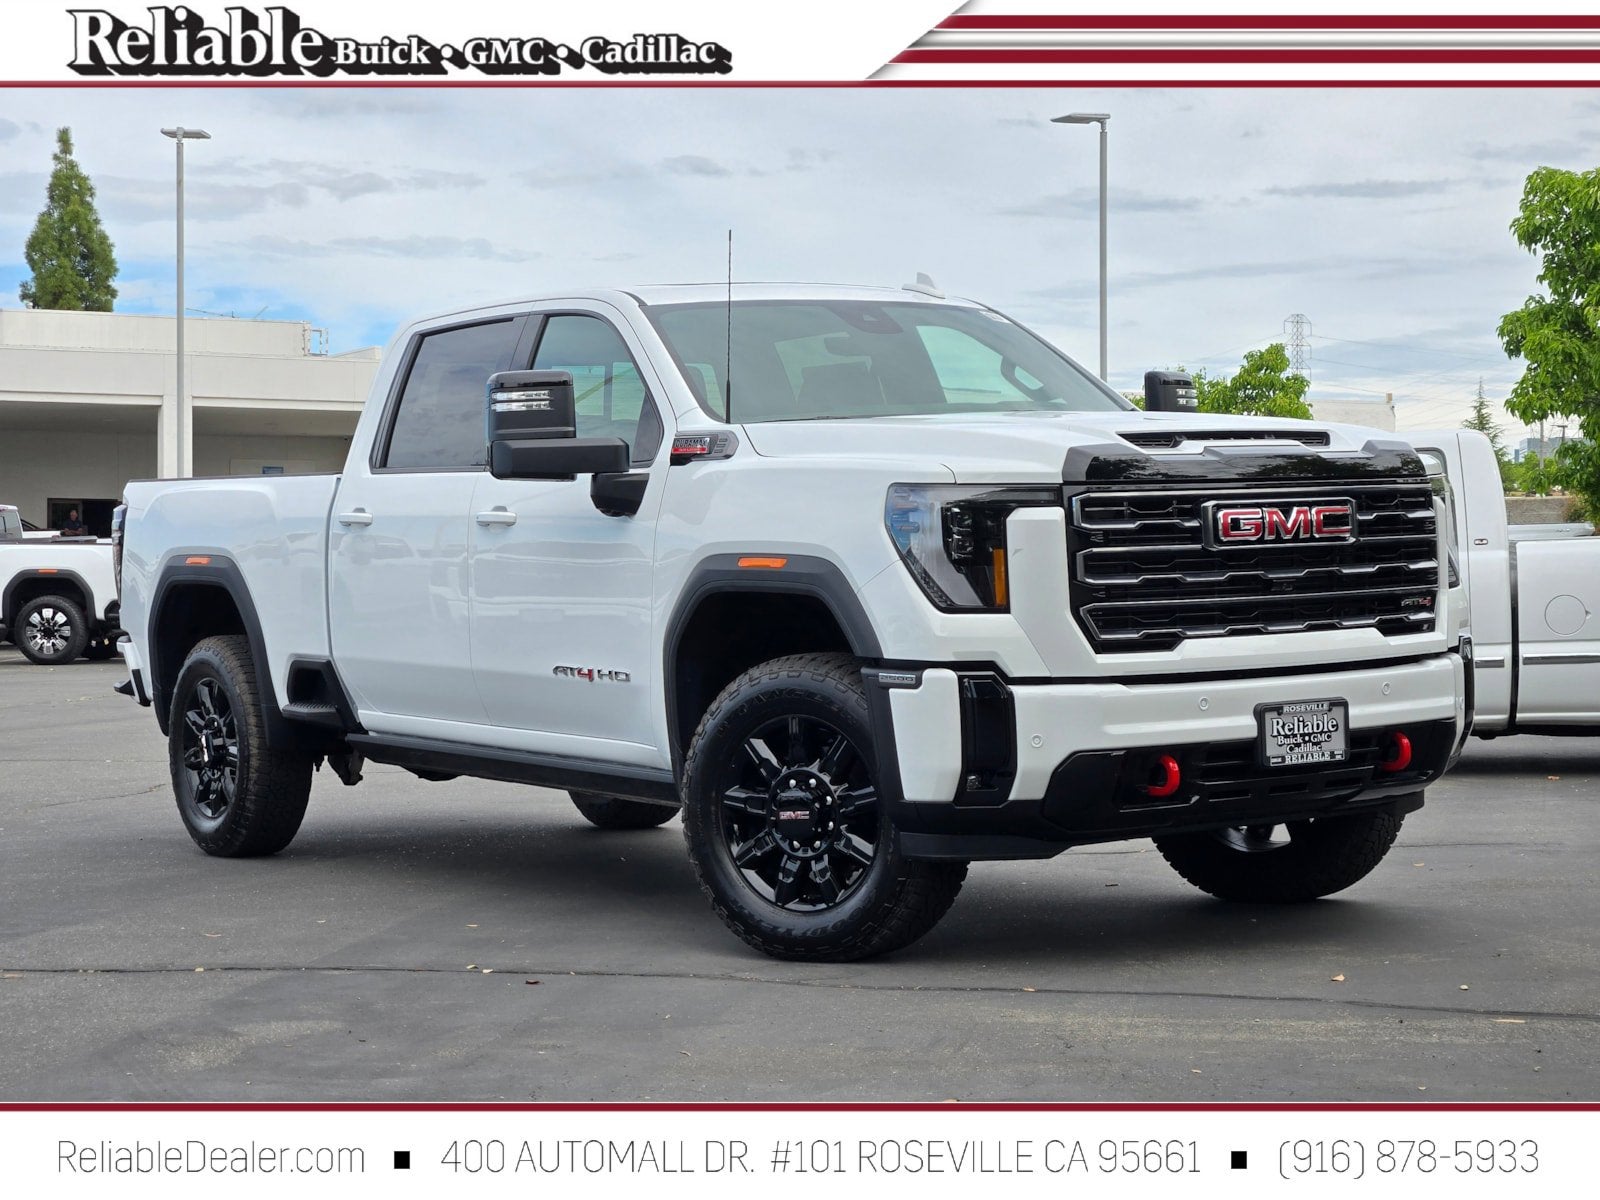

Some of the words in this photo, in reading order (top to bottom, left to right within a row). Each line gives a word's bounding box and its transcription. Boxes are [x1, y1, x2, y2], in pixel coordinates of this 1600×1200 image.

[1217, 505, 1352, 541] GMC
[552, 665, 594, 682] AT4
[597, 669, 631, 682] HD
[1284, 703, 1328, 712] ROSEVILLE
[1271, 713, 1338, 736] Reliable
[1277, 734, 1303, 745] Buick
[1310, 732, 1332, 742] GMC
[1286, 743, 1322, 753] Cadillac
[1285, 752, 1330, 764] RELIABLE
